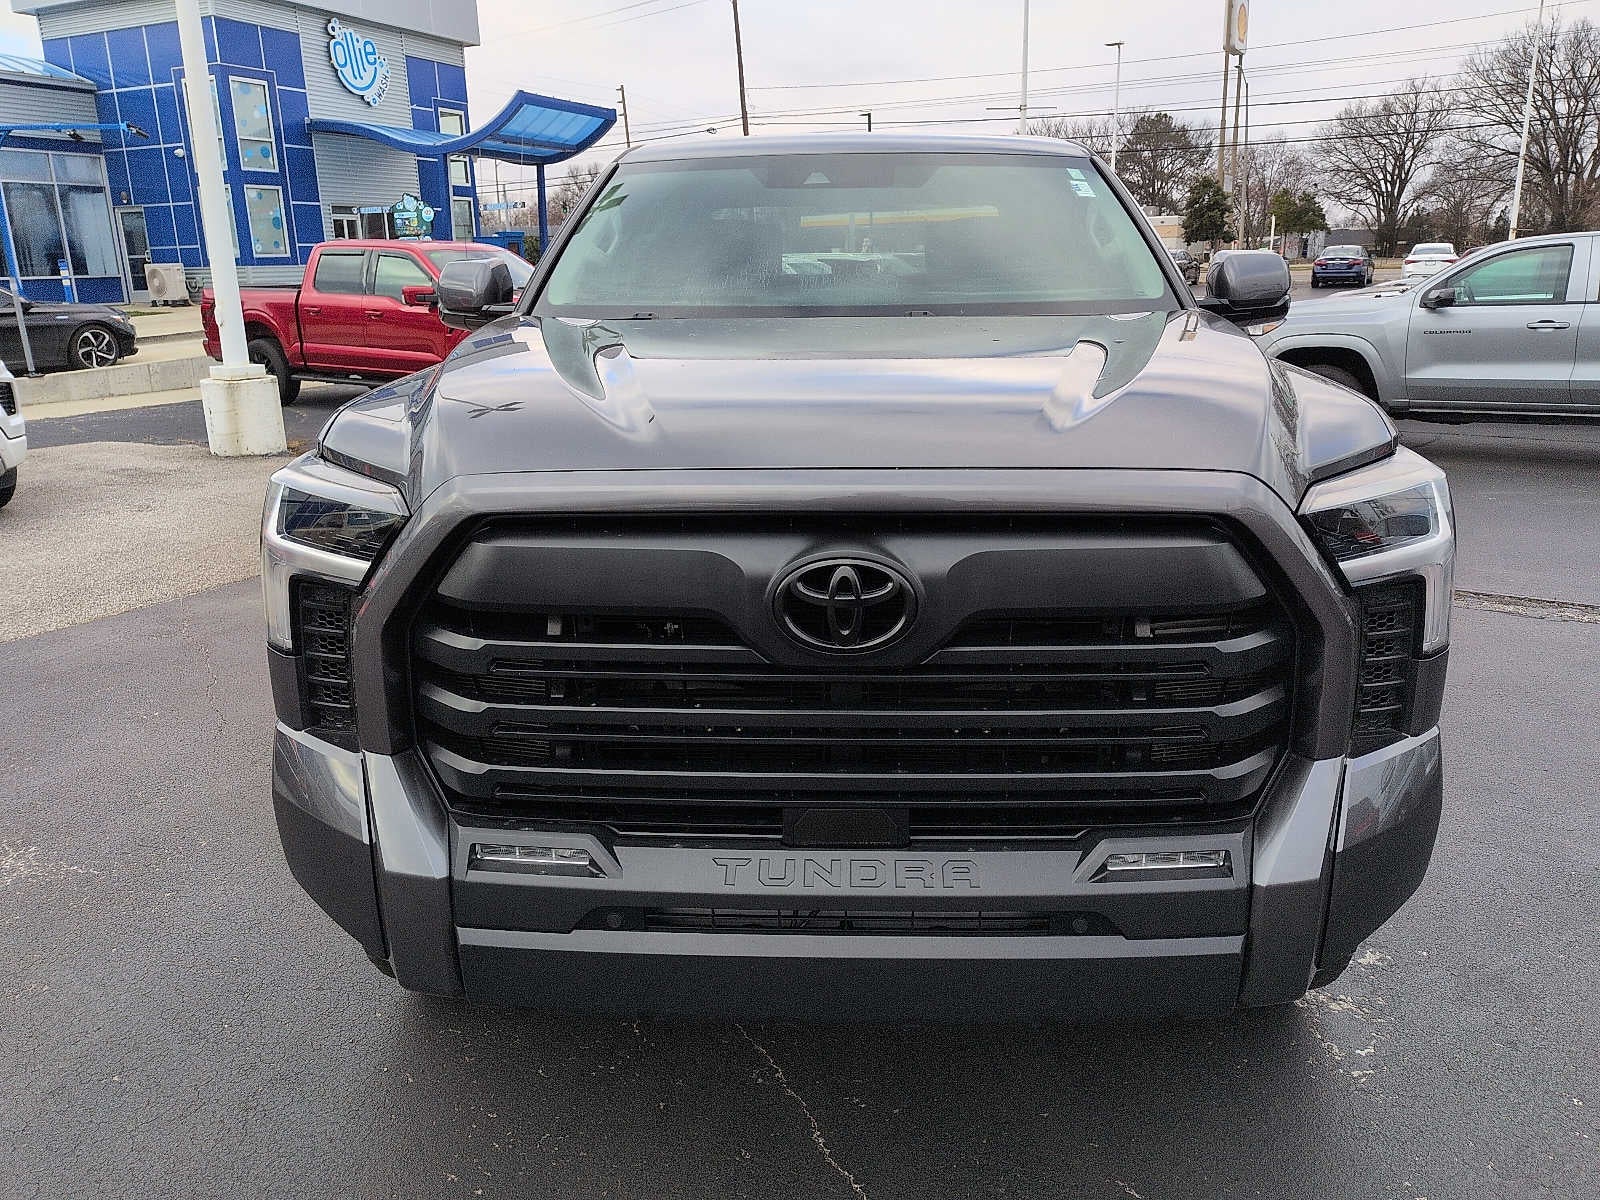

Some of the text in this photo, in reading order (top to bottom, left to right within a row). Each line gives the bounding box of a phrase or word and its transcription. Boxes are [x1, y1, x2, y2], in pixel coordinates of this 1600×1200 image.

[333, 32, 377, 80] ollie
[375, 74, 390, 100] WASH
[712, 857, 980, 889] TUNDRA
